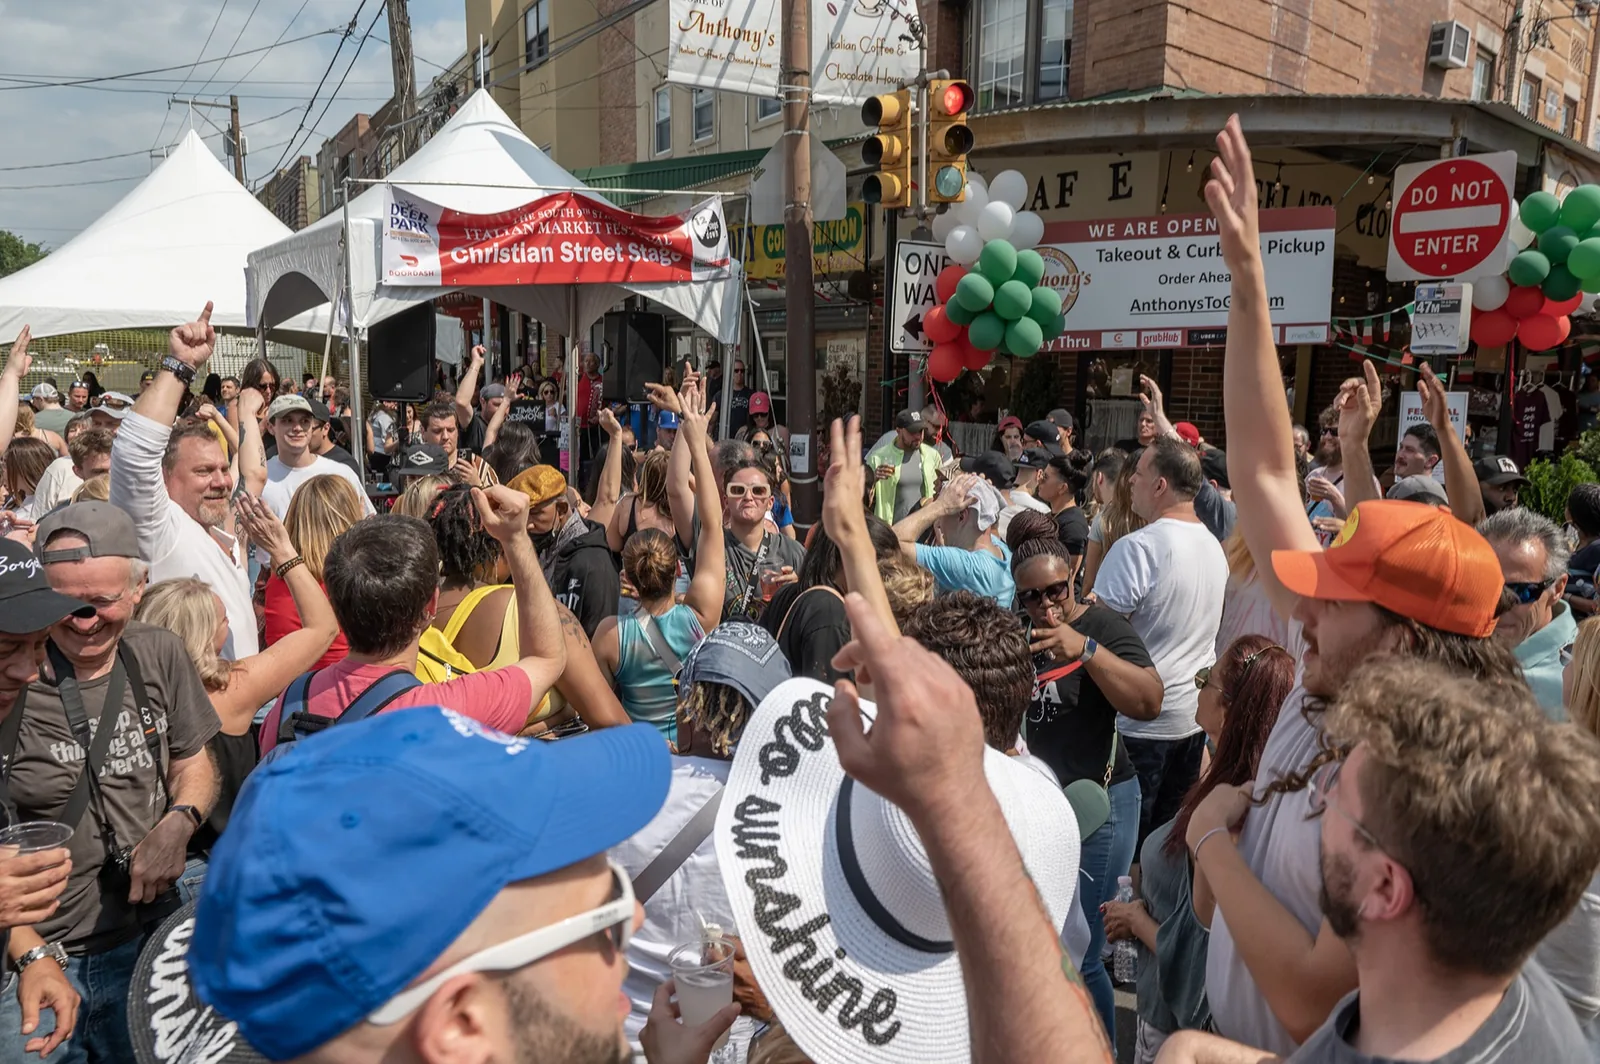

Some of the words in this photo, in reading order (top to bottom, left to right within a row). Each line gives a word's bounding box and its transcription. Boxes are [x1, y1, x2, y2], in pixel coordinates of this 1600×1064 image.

[678, 10, 775, 52] Anthony's
[678, 43, 696, 55] Italian
[697, 47, 718, 59] Coffee
[727, 52, 754, 65] Chocolate
[826, 33, 856, 51] Italian
[859, 36, 894, 56] Coffee
[825, 62, 873, 82] Chocolate
[1411, 185, 1438, 206] DO
[1451, 179, 1493, 202] NOT
[391, 203, 429, 223] DEER
[538, 207, 574, 218] SOUTH
[390, 217, 429, 234] PARK
[464, 221, 535, 240] ITALIAN
[538, 221, 602, 235] MARKET
[767, 216, 857, 254] CORATION
[1088, 223, 1115, 238] WE
[1124, 221, 1158, 236] ARE
[1167, 218, 1217, 234] OPEN
[451, 242, 554, 264] Christian
[560, 241, 624, 263] Street
[628, 242, 683, 267] Stage
[1096, 246, 1161, 263] Takeout
[1167, 244, 1181, 259] &
[1268, 238, 1325, 256] Pickup
[1414, 234, 1480, 256] ENTER
[389, 269, 434, 277] DOORDASH
[1158, 272, 1195, 286] Order
[1198, 271, 1232, 283] Ahea
[903, 282, 937, 306] WA
[1130, 296, 1284, 312] AnthonysToGm
[1416, 301, 1440, 313] 47M
[1058, 335, 1090, 348] Thru
[1143, 331, 1179, 345] grubHub
